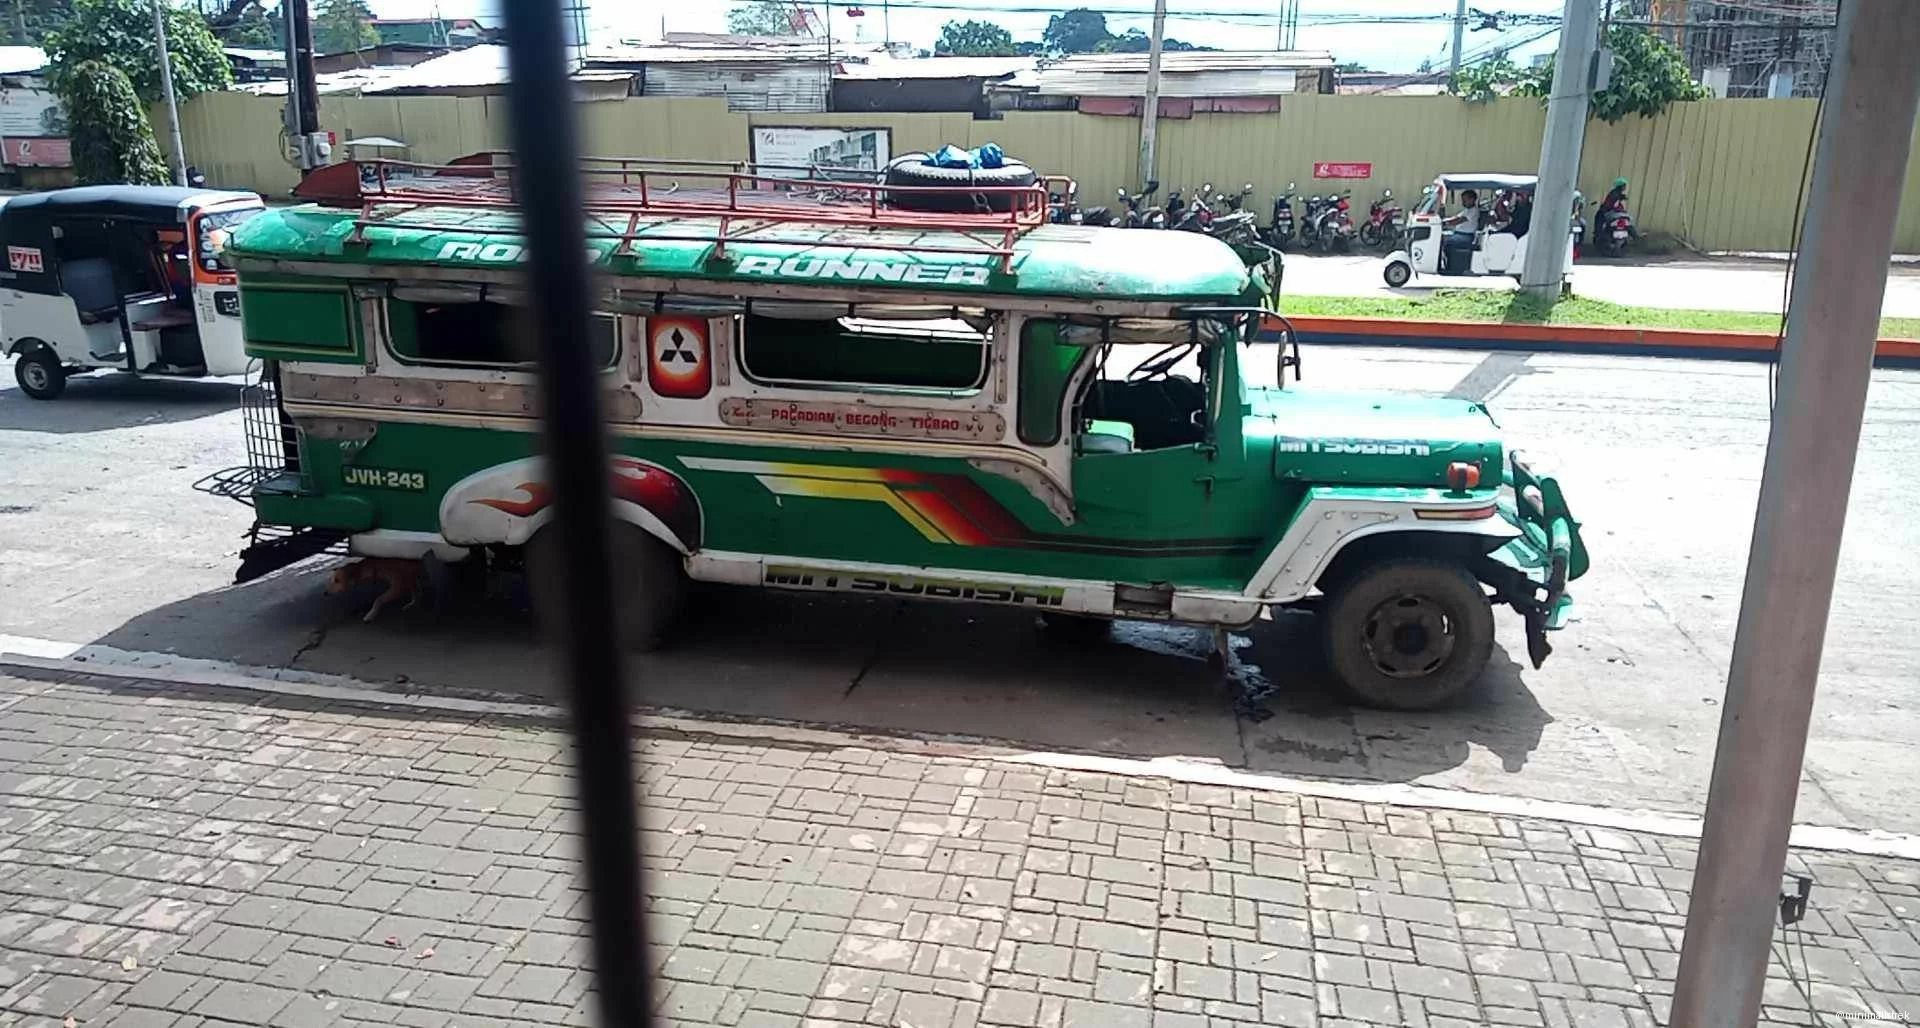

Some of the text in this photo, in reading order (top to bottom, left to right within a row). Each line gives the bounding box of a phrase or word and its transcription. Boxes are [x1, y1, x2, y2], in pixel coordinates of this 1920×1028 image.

[436, 241, 991, 286] RO RUNNER
[771, 408, 835, 424] PAGADIAN
[909, 416, 960, 431] TIGBAO
[1279, 435, 1431, 457] MITSUBISHI
[765, 564, 1065, 607] MITSUBISHI
